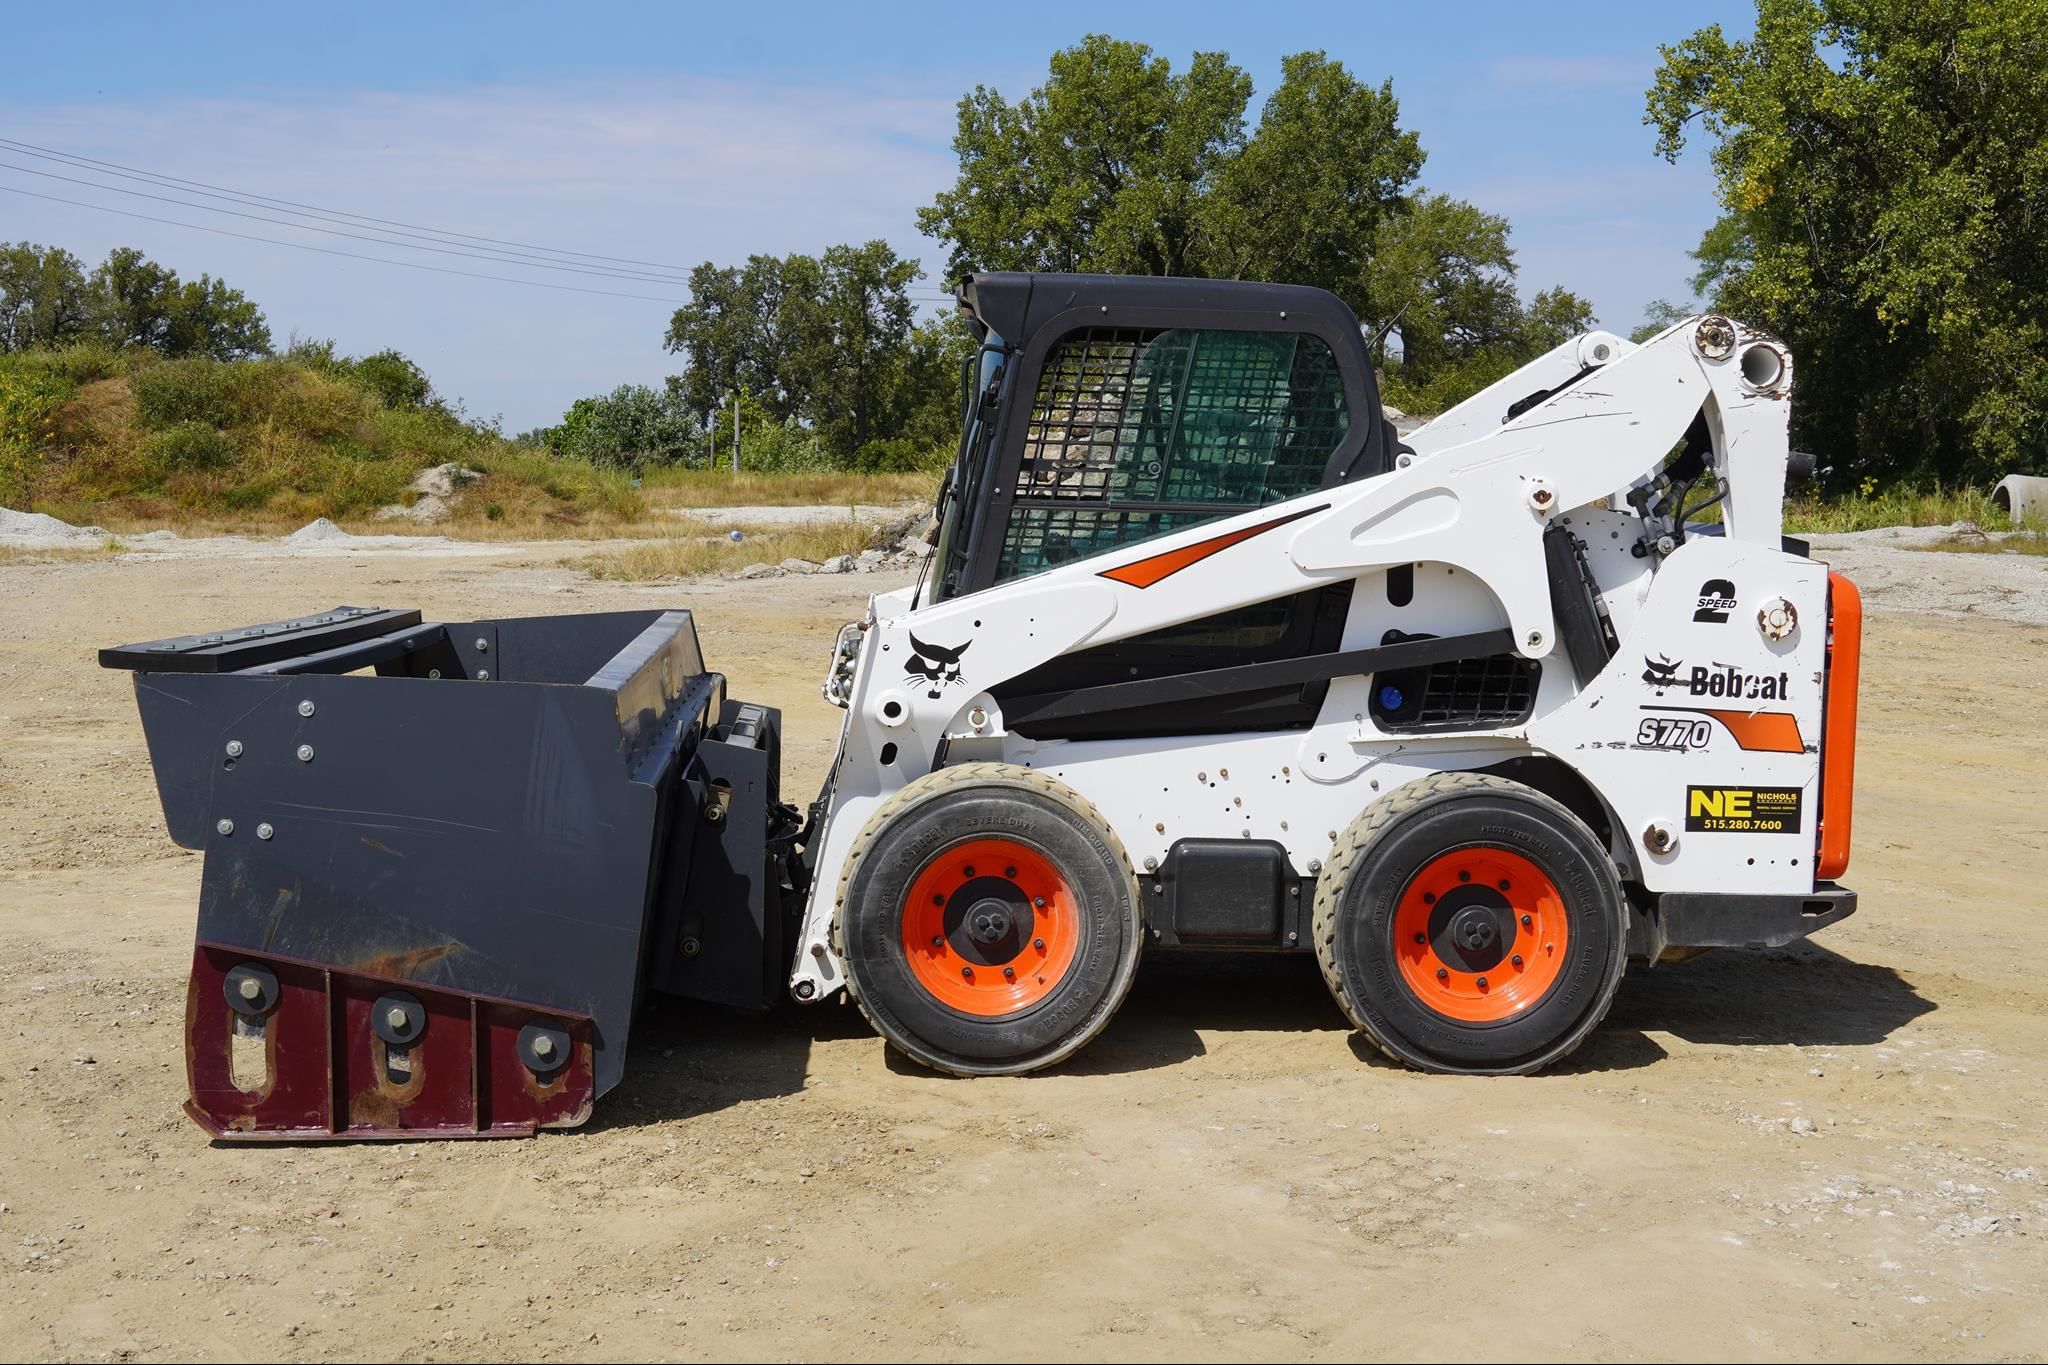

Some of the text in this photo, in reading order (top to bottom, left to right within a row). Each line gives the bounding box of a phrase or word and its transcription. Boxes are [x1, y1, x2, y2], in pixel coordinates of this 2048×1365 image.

[1693, 579, 1736, 624] 2
[1697, 598, 1737, 609] SPEED
[1637, 718, 1711, 748] S770
[1690, 790, 1753, 817] NE
[1704, 820, 1782, 830] 515.280.7600
